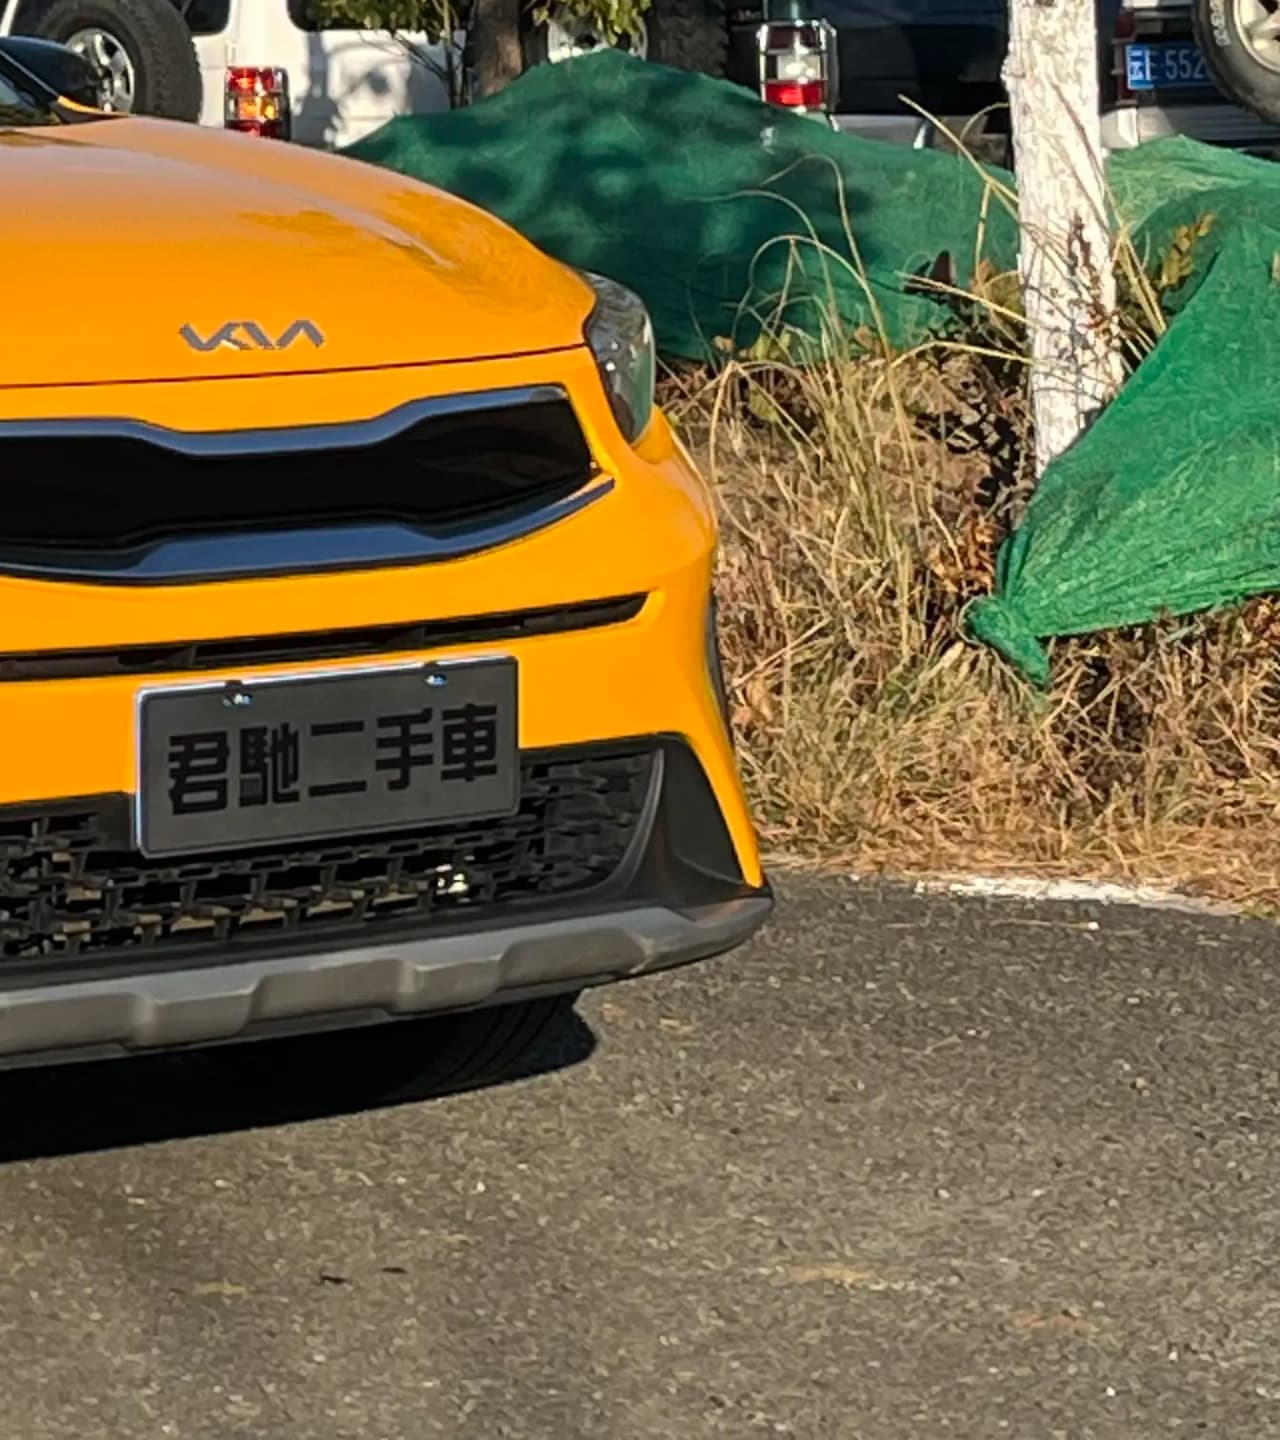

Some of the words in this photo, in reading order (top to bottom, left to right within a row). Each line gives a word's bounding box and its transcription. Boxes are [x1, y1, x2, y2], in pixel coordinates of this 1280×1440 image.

[179, 320, 325, 352] KIA
[167, 702, 498, 815] 君馳二手車
